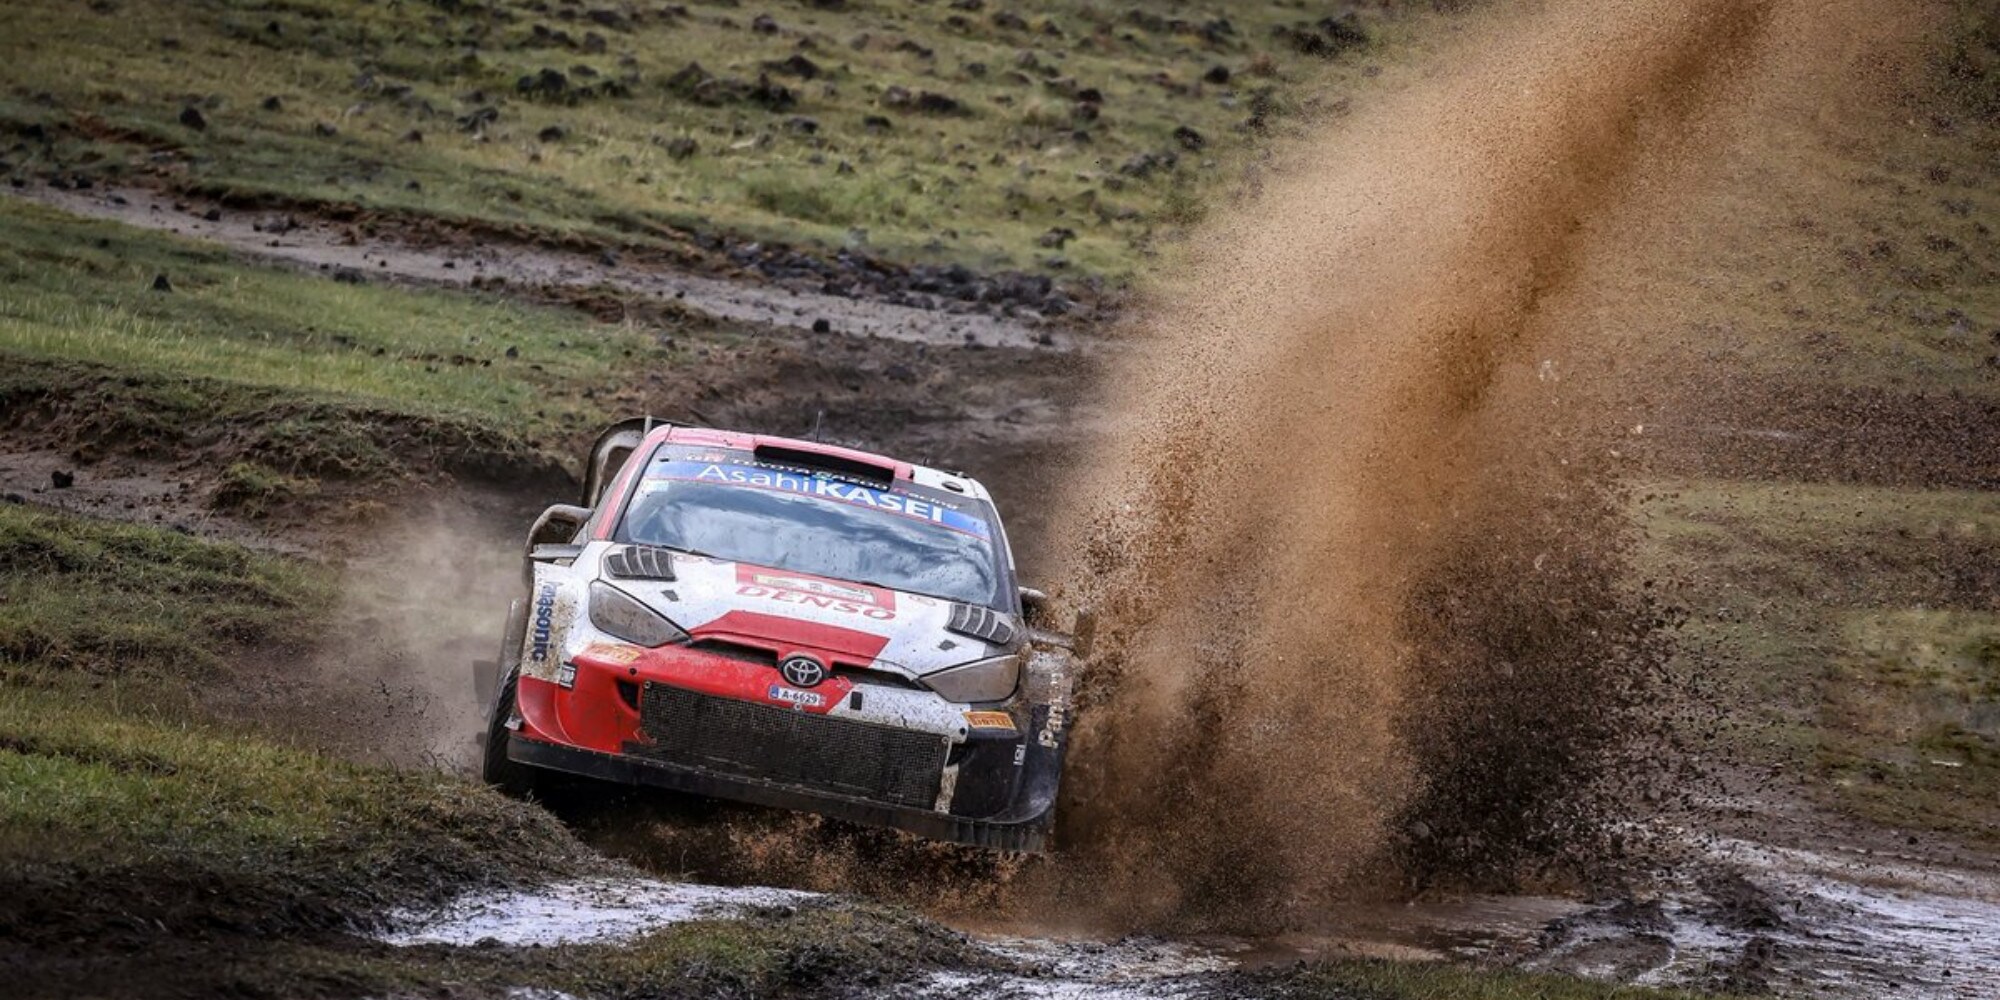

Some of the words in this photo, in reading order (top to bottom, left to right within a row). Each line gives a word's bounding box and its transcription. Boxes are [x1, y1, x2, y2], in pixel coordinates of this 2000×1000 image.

[732, 459, 811, 475] TOYOTA
[736, 586, 896, 620] DENSO
[532, 581, 562, 661] nasonic
[782, 690, 818, 703] A-6629
